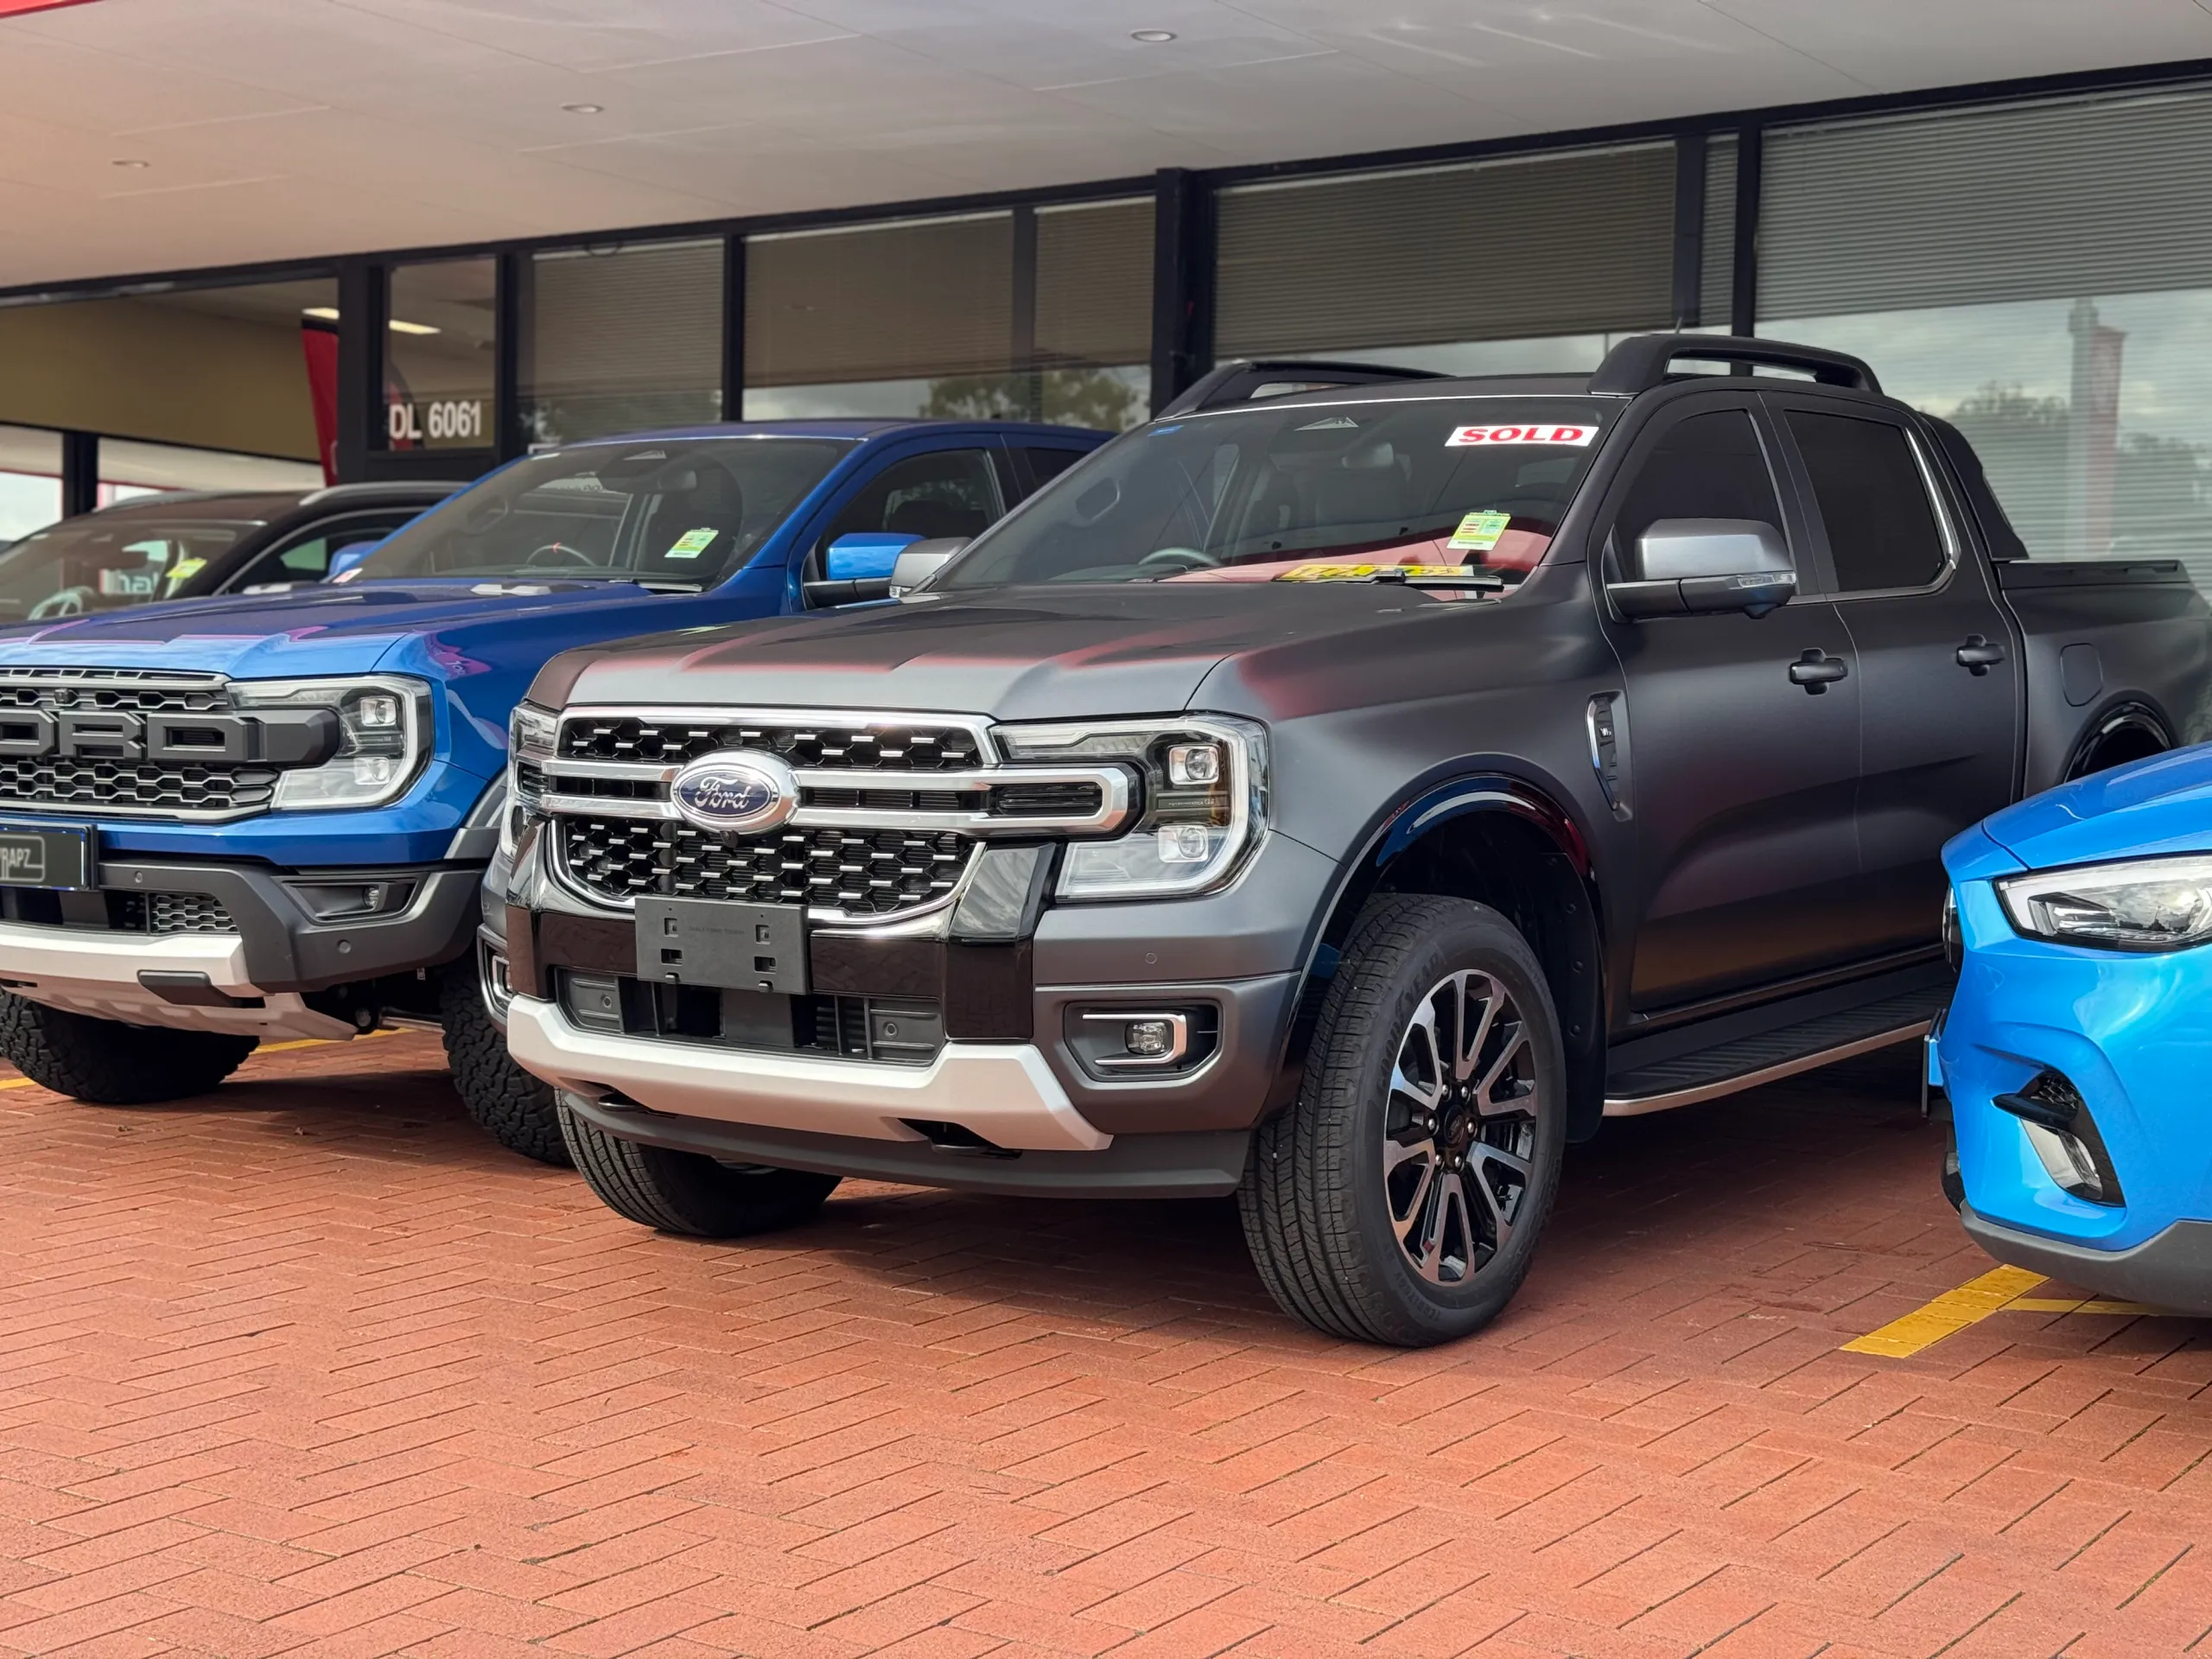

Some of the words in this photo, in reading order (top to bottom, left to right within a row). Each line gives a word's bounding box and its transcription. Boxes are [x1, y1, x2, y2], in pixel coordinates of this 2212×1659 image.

[389, 403, 423, 439] DL
[428, 400, 481, 438] 6061
[1459, 428, 1582, 442] SOLD
[695, 776, 752, 809] Ford
